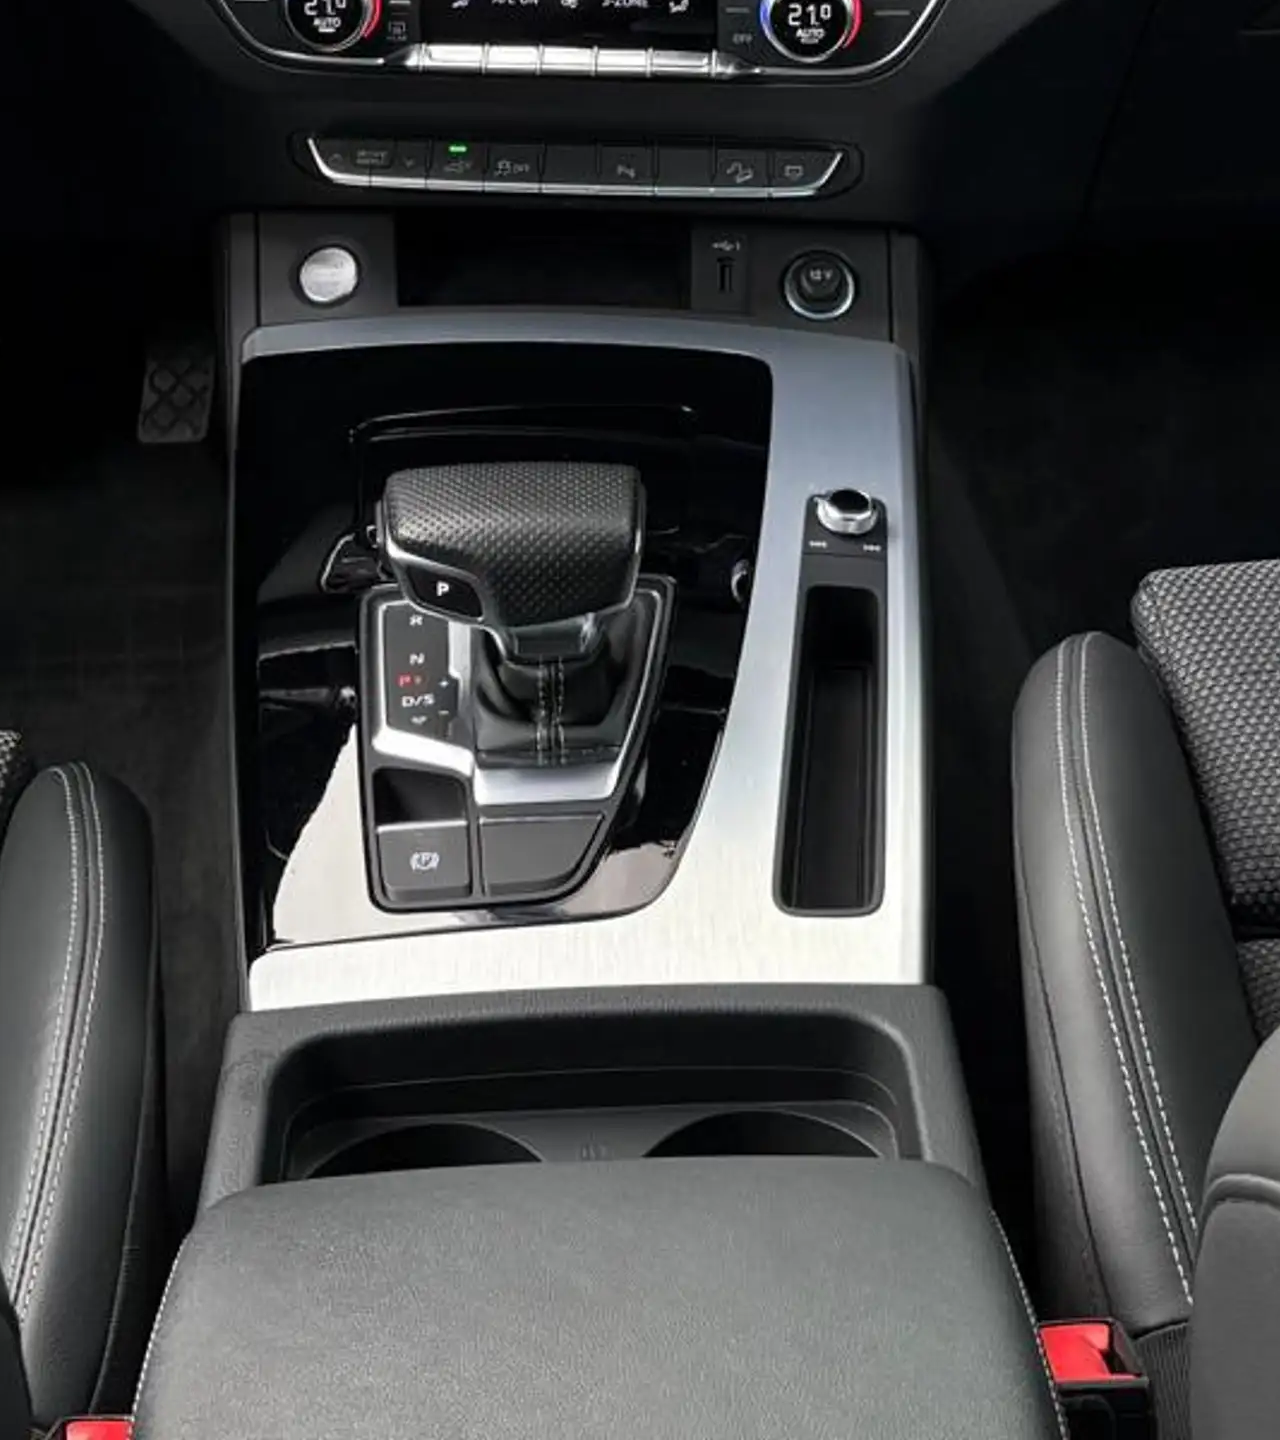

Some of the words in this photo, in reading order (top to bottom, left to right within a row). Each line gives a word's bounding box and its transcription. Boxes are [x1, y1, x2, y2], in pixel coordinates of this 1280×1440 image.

[436, 581, 450, 597] P
[410, 653, 424, 665] N
[402, 694, 434, 707] D/S
